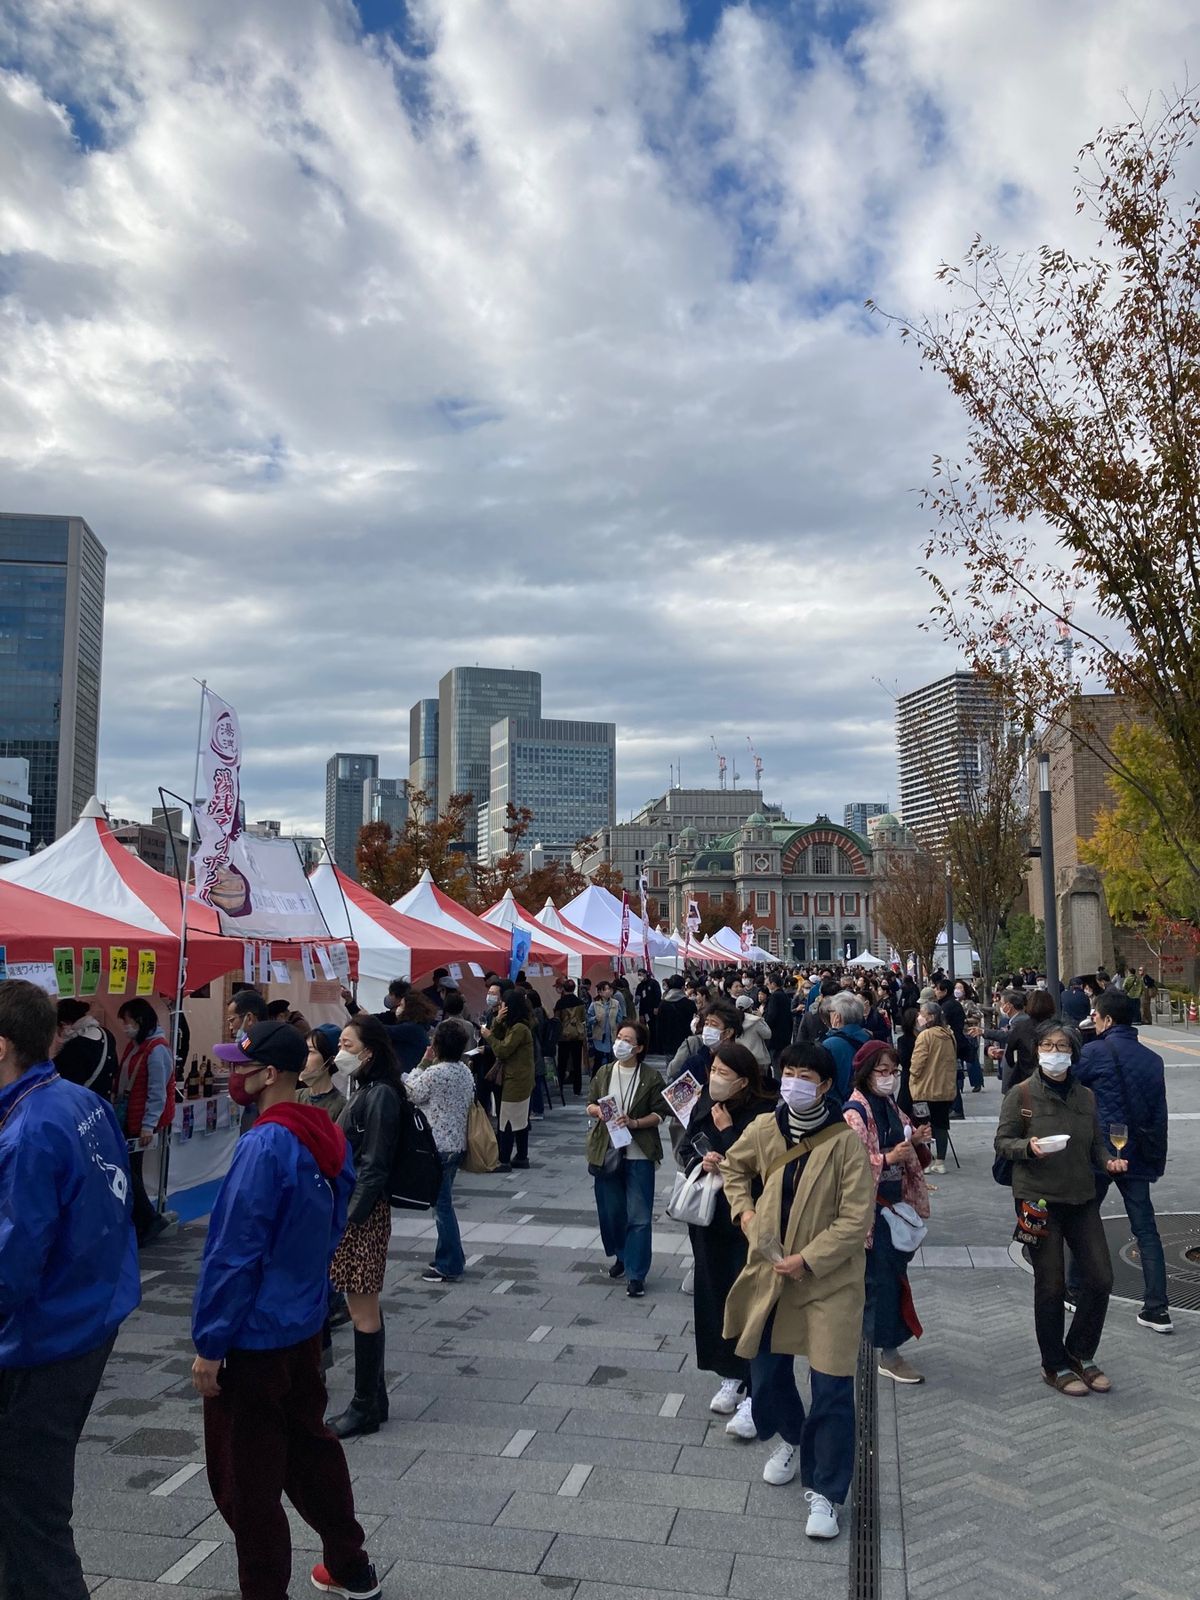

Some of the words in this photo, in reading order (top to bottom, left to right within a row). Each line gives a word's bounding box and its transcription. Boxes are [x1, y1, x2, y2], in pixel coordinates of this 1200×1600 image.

[8, 963, 54, 977] 湯浅ワイナリー
